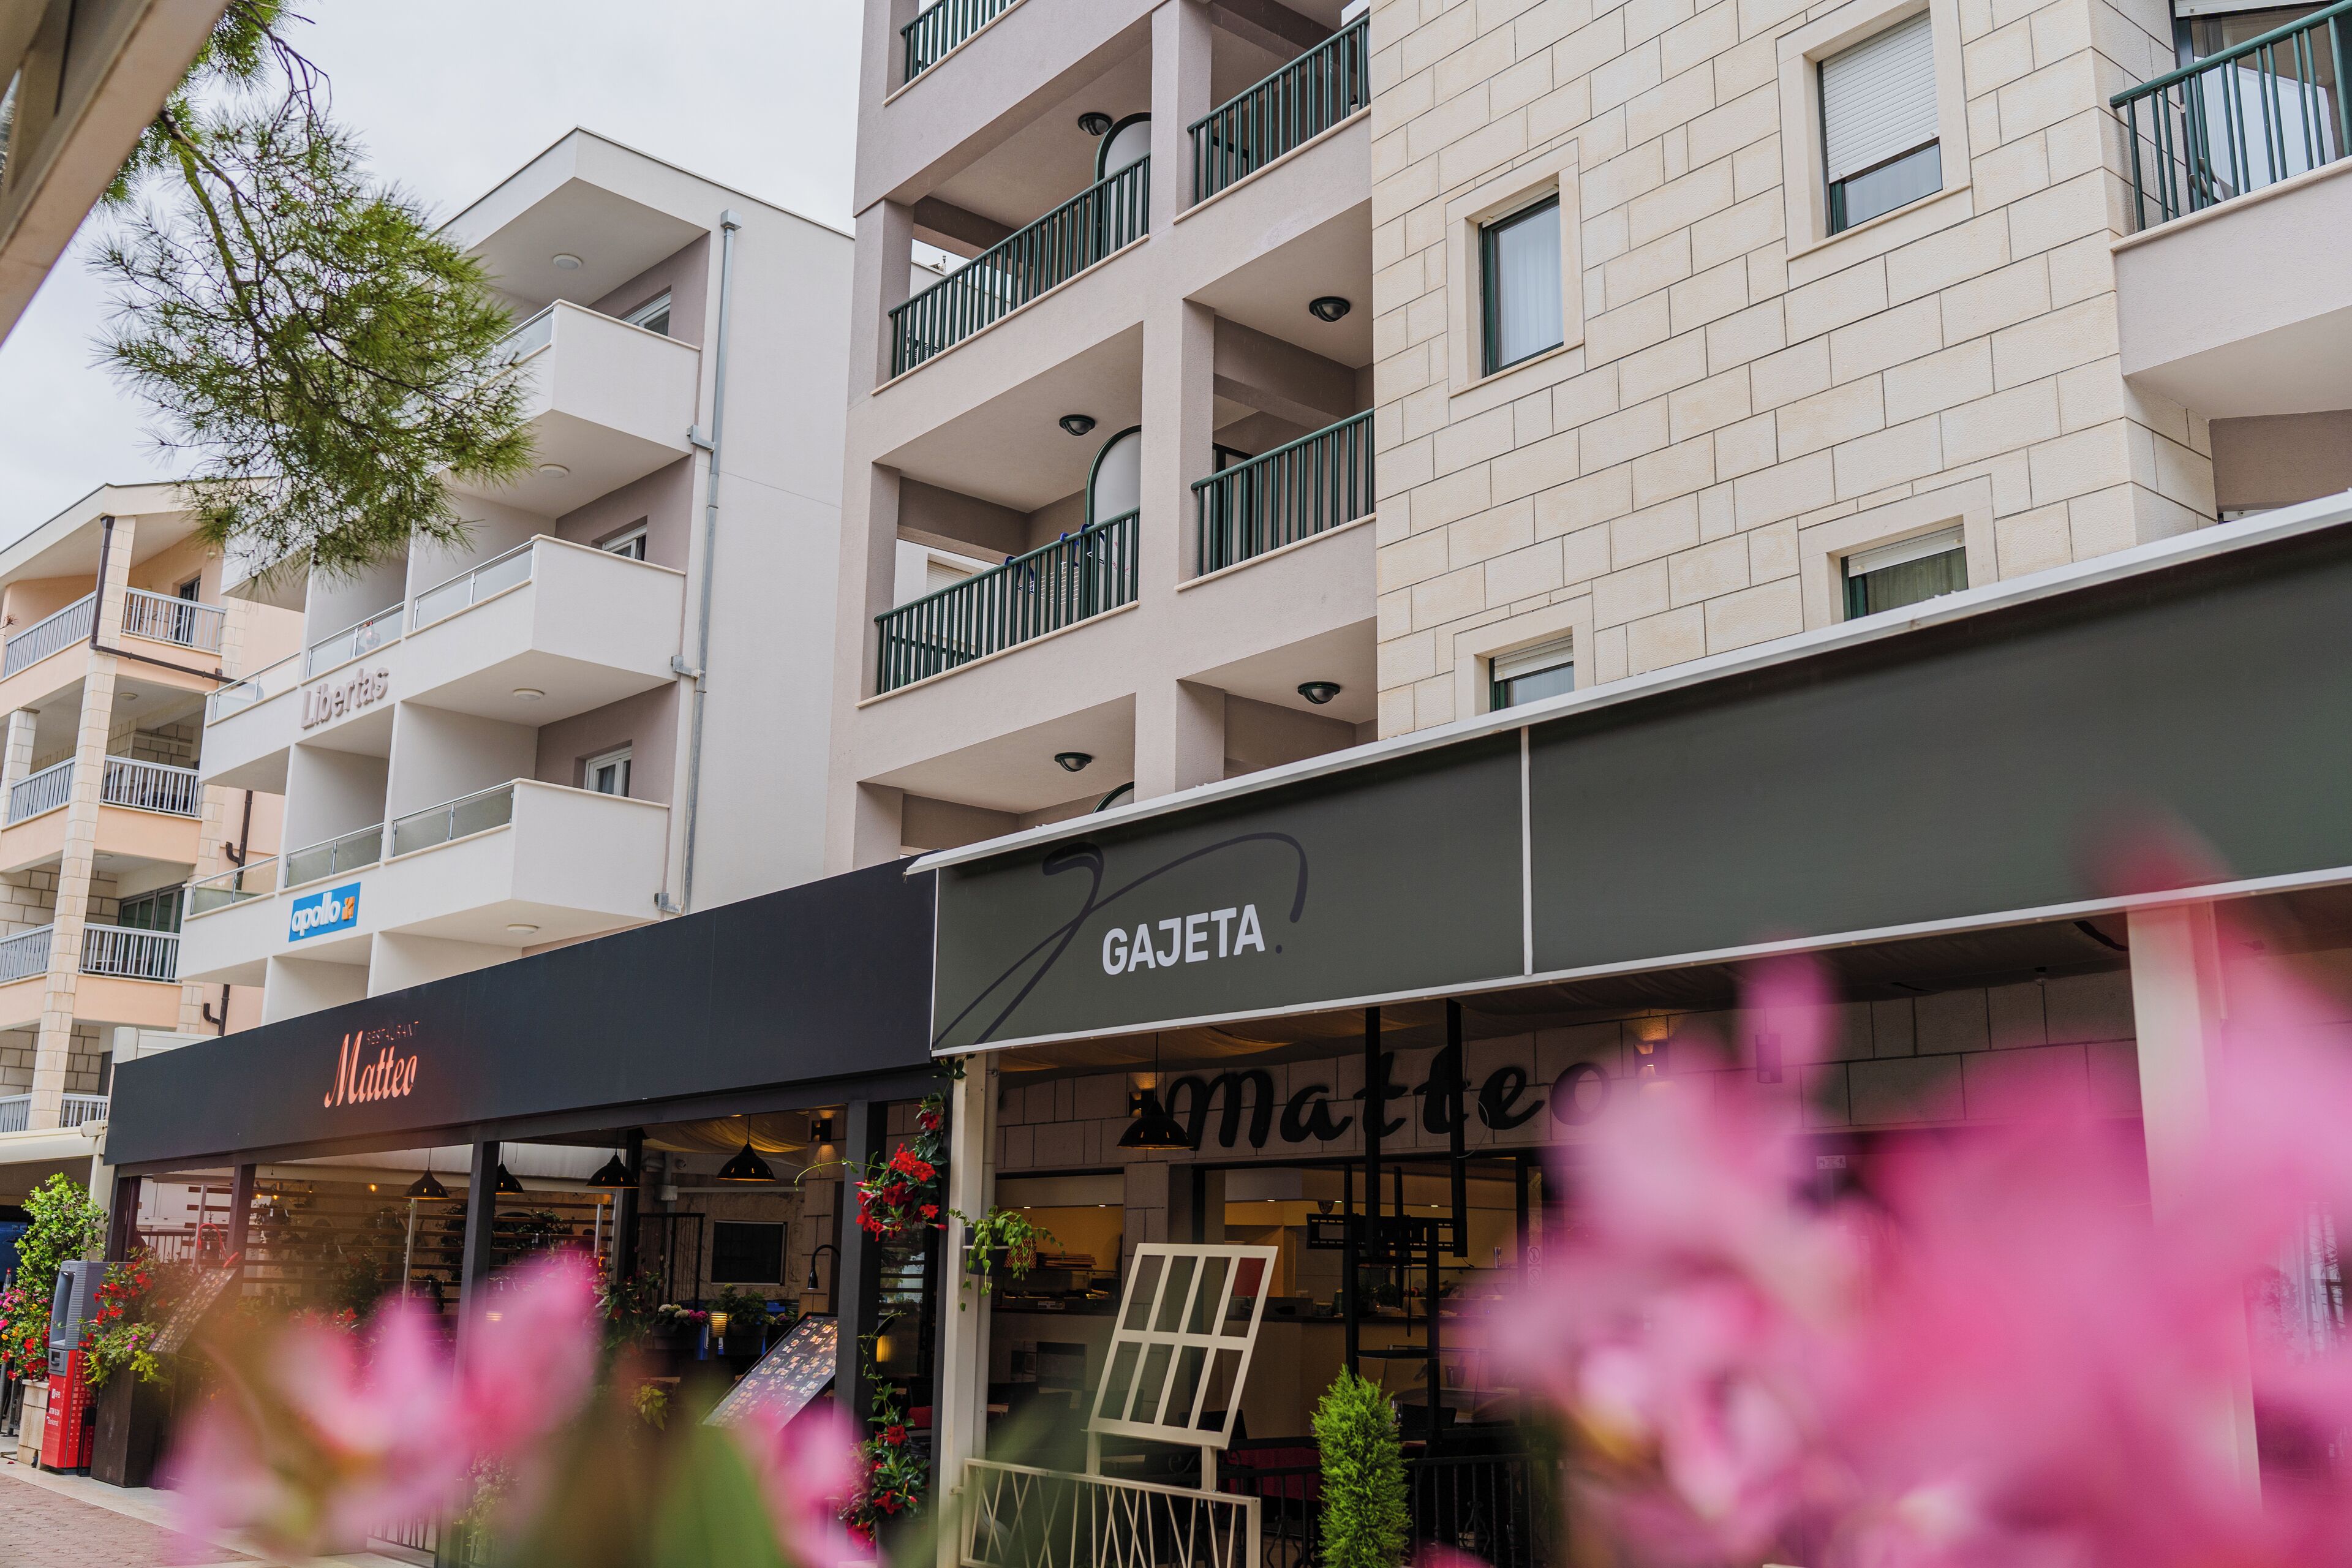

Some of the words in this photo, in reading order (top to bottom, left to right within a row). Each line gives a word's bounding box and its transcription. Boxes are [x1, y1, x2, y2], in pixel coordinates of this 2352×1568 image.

[301, 667, 389, 729] Libertas
[291, 891, 341, 937] apollo
[1102, 903, 1266, 976] GAJETA
[324, 1030, 417, 1107] Matteo
[1166, 1045, 1612, 1150] Matteo
